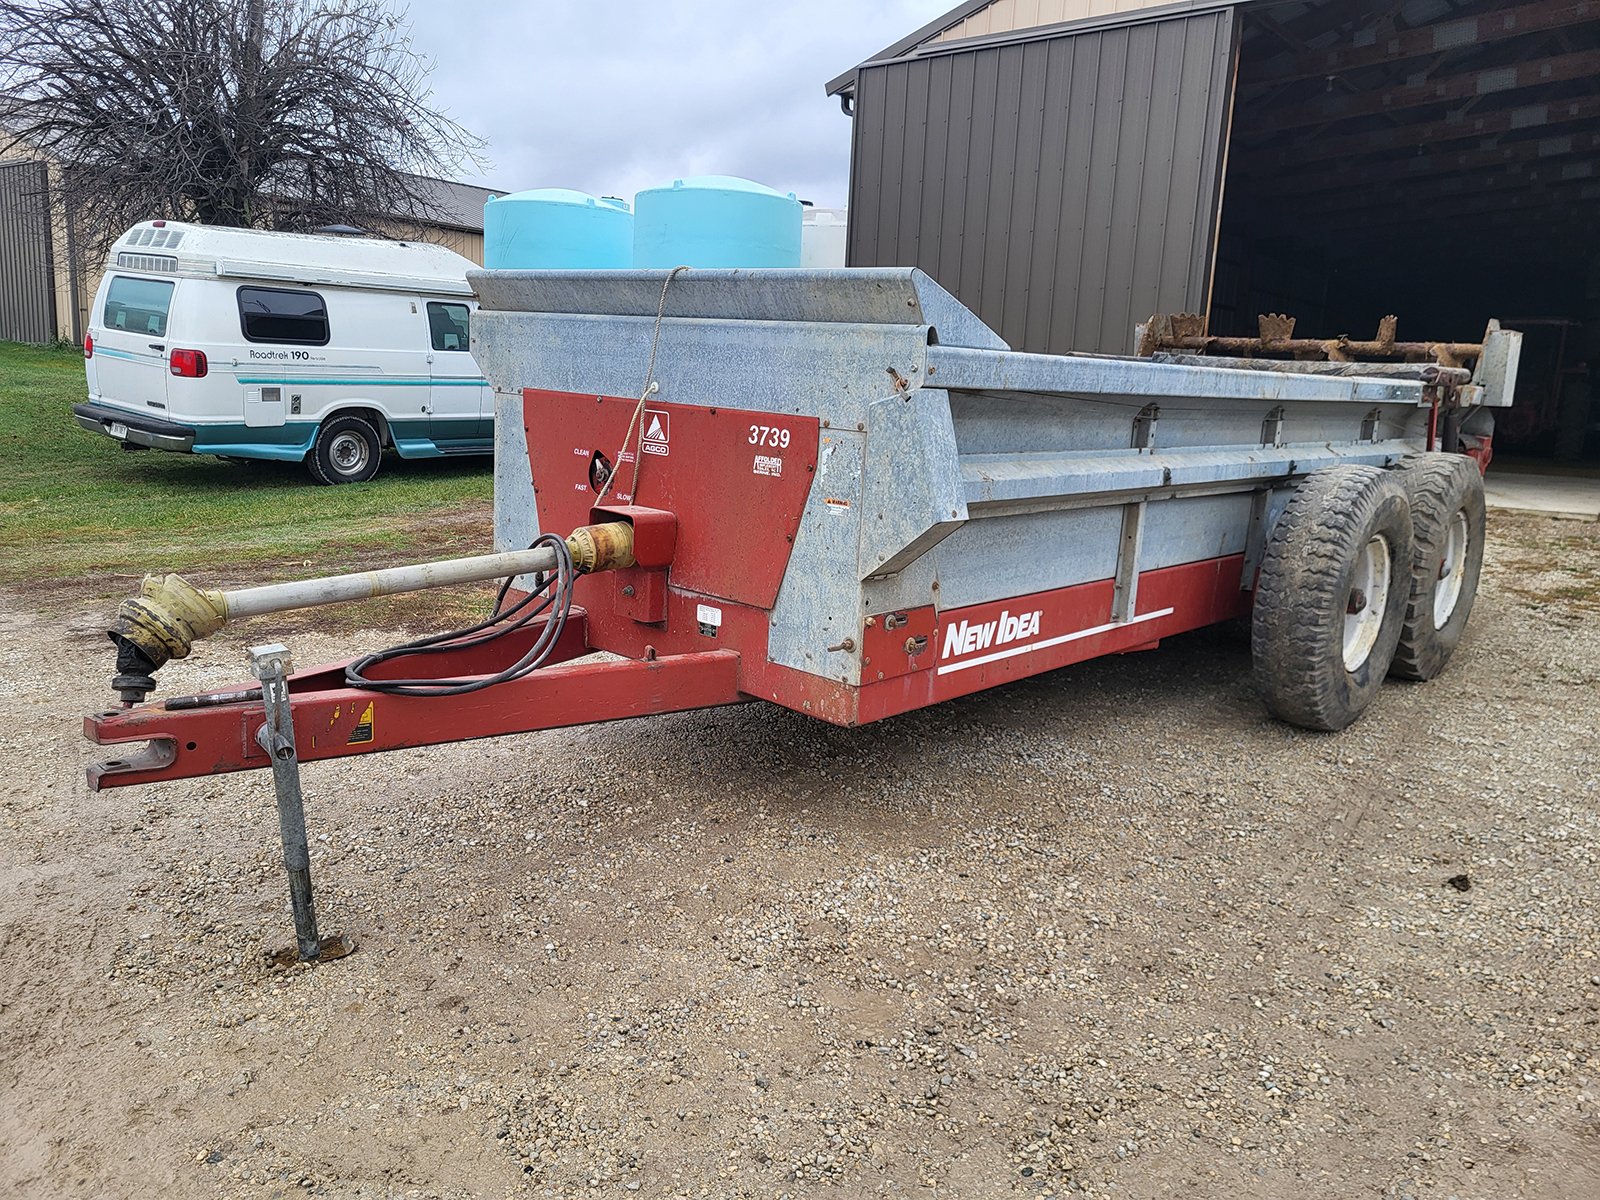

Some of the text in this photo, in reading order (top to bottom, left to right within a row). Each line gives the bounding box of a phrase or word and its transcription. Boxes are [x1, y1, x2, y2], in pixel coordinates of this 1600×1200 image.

[249, 350, 289, 360] Roadtrek
[290, 351, 310, 361] 190
[748, 424, 791, 449] 3739
[573, 448, 590, 457] CLEAN
[645, 444, 667, 454] AGCO
[574, 483, 588, 491] FAST
[941, 620, 998, 660] NEW
